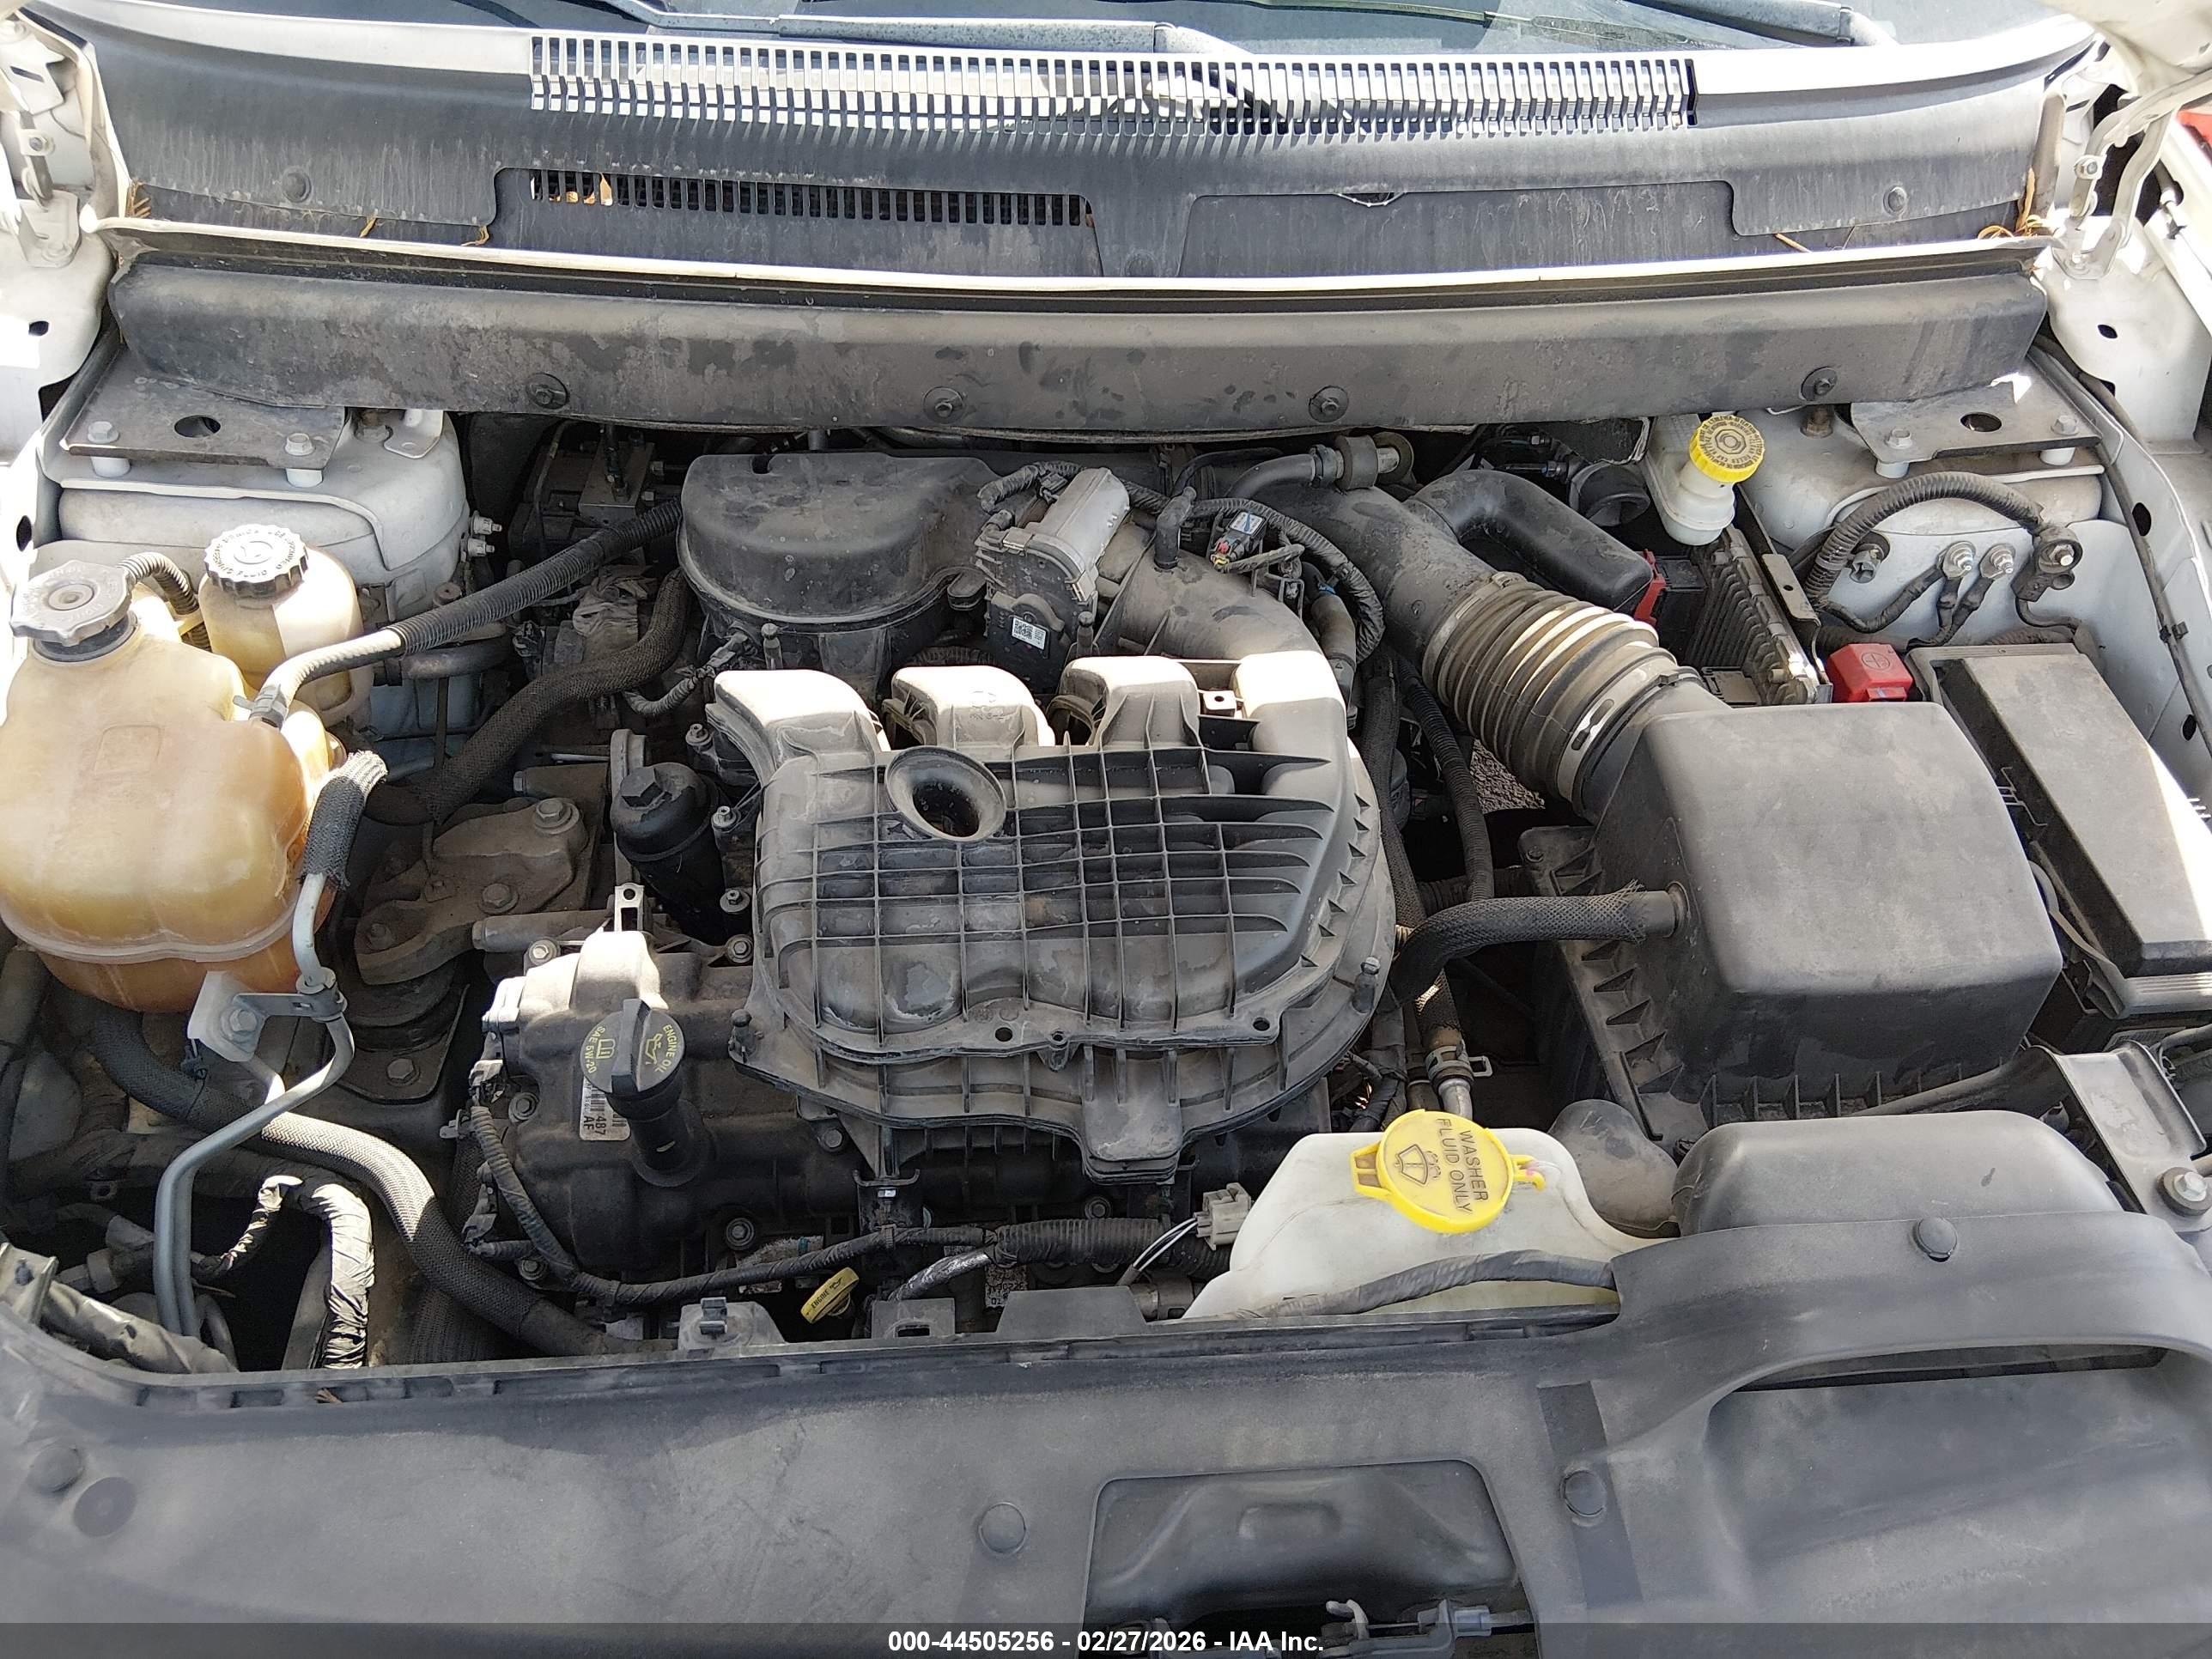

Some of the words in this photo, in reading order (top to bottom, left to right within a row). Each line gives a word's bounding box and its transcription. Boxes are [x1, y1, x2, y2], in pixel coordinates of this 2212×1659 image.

[589, 1026, 605, 1043] SAE
[662, 1024, 678, 1058] ENGINE
[585, 1045, 598, 1073] 5W-20
[654, 1059, 672, 1073] OIL
[584, 1115, 594, 1130] AF
[1436, 1118, 1461, 1164] FLUID
[1449, 1170, 1474, 1212] ONLY
[1459, 1130, 1489, 1201] WASHER
[811, 1289, 830, 1309] ENGINE
